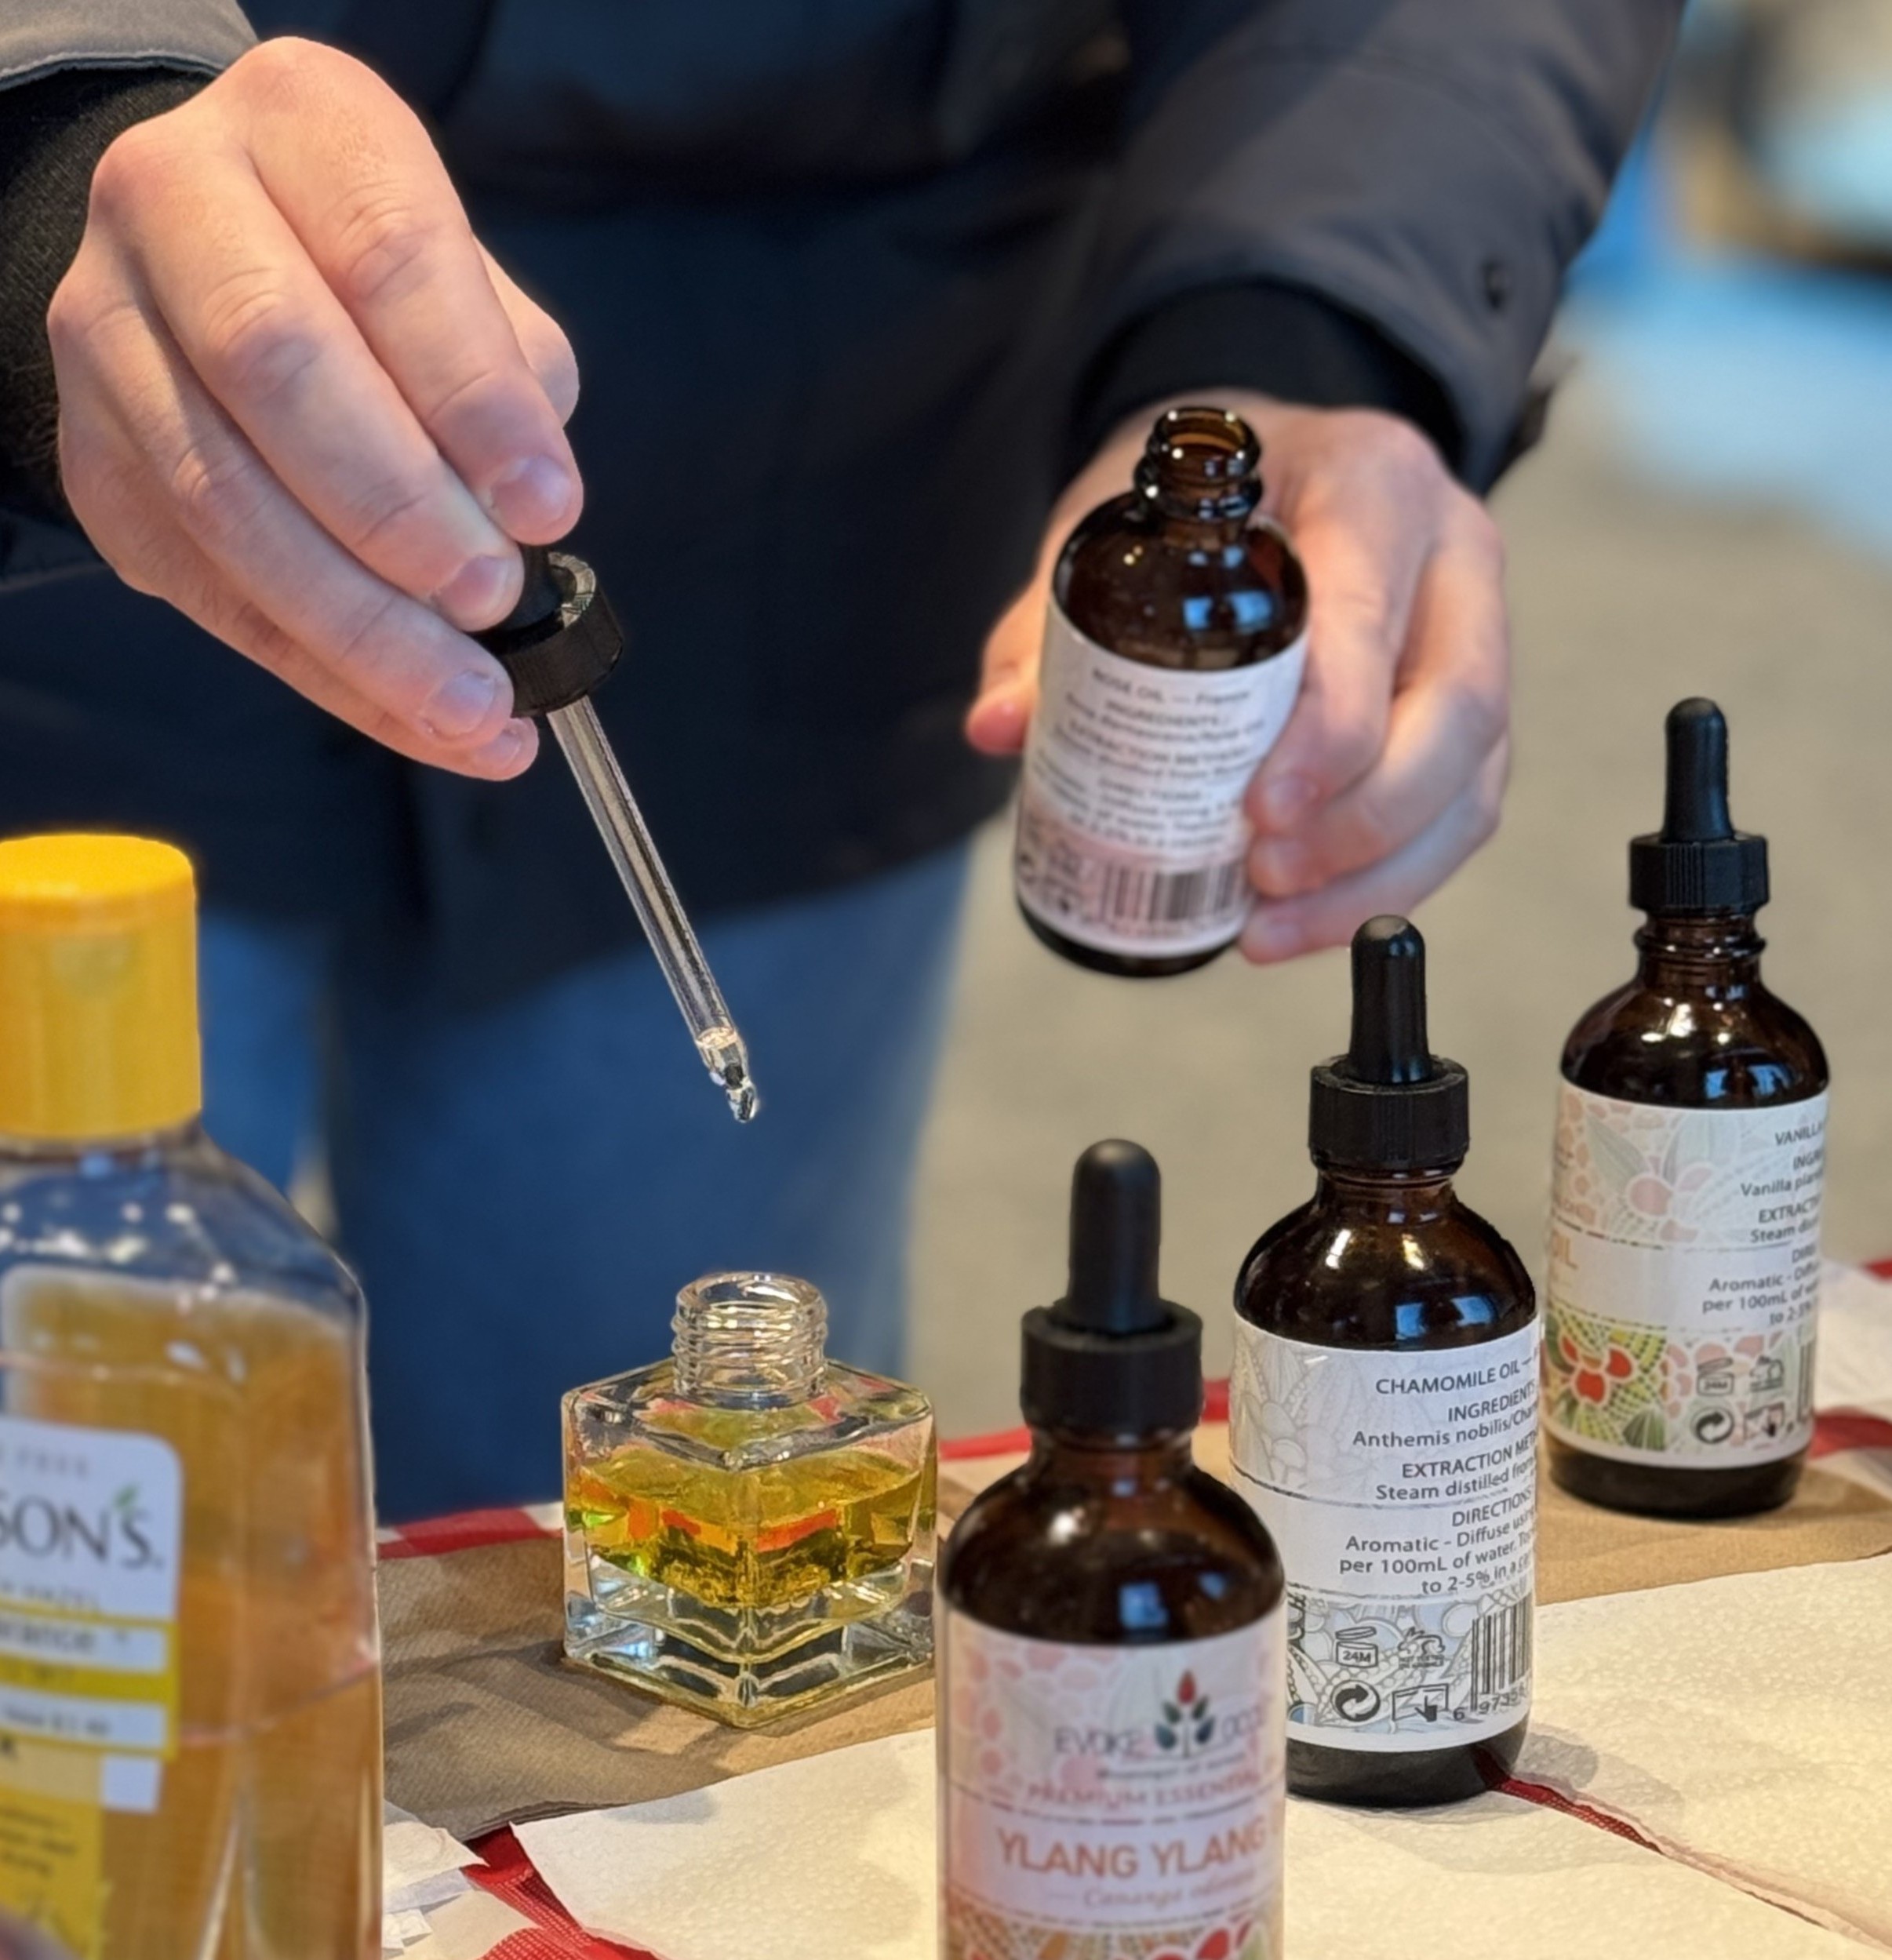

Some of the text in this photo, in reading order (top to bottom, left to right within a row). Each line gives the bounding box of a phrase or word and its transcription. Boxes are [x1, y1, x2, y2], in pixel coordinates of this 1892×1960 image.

[1740, 1178, 1792, 1197] Vanilla
[1750, 1225, 1796, 1244] Steam
[1708, 1272, 1784, 1293] Aromatic
[1702, 1298, 1733, 1315] per
[1740, 1290, 1788, 1310] 100mL
[1770, 1311, 1785, 1325] to
[1376, 1367, 1497, 1395] CHAMOMILE
[1499, 1360, 1521, 1380] OIL
[1352, 1430, 1450, 1449] Anthemis
[1402, 1445, 1512, 1479] EXTRACTION
[1375, 1484, 1439, 1501] Steam
[1445, 1467, 1509, 1497] distilled
[1345, 1535, 1440, 1553] Aromatic
[1457, 1522, 1510, 1548] Diffuse
[1339, 1558, 1374, 1575] per
[1381, 1556, 1448, 1574] 100mL
[1452, 1550, 1472, 1569] of
[1475, 1540, 1517, 1565] water.
[1421, 1579, 1442, 1595] to
[1447, 1568, 1490, 1592] 2-5%
[1494, 1565, 1507, 1580] in
[1342, 1649, 1371, 1663] 24M
[1453, 1707, 1466, 1721] 6
[996, 1814, 1267, 1879] YLANG YLANG
